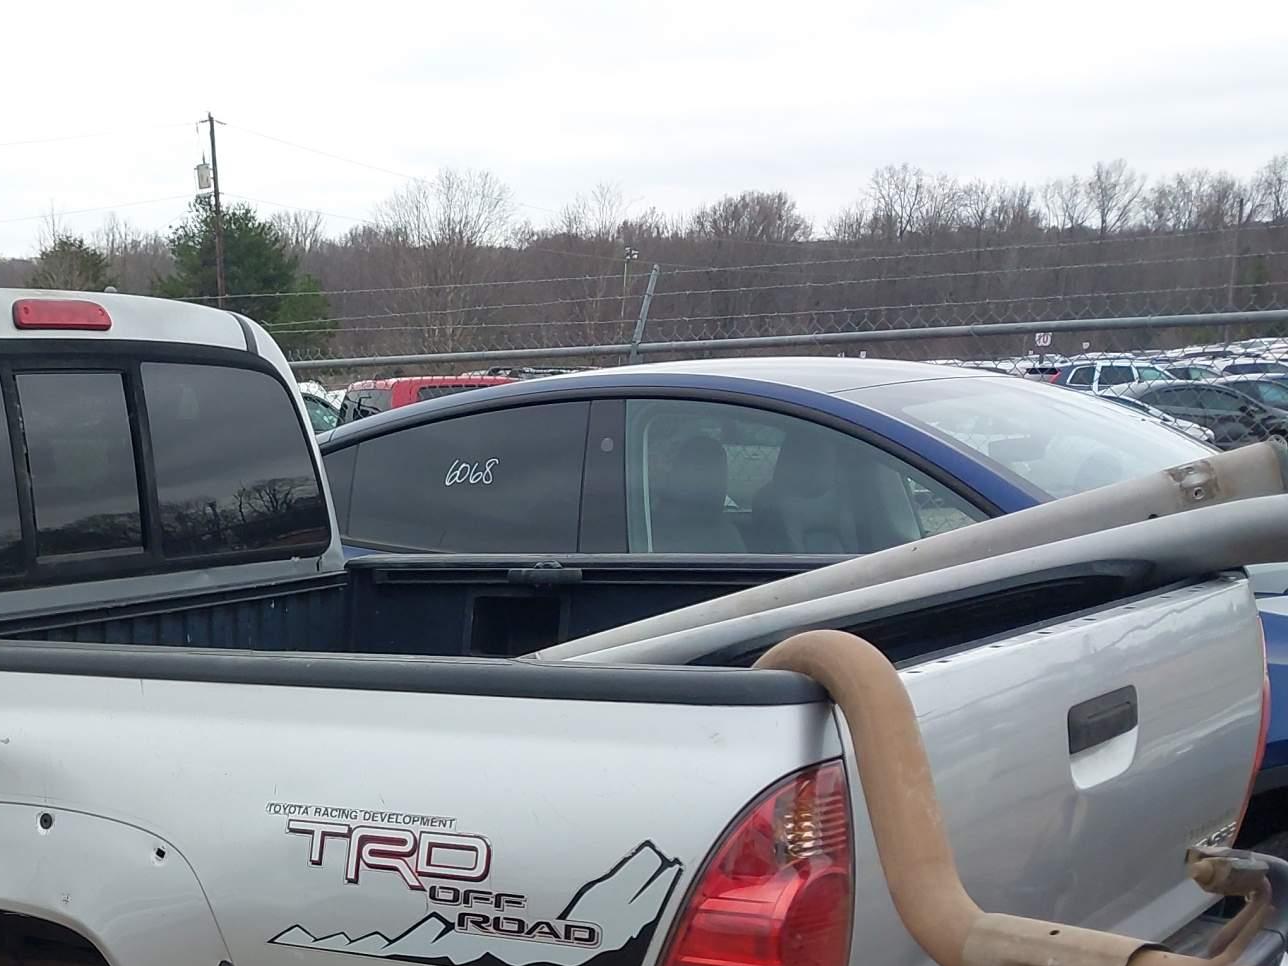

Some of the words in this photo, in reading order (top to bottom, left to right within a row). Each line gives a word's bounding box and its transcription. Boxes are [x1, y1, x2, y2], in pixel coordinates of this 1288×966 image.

[445, 458, 499, 486] 6068
[267, 803, 311, 816] TOYOTA
[313, 807, 359, 820] RACING
[362, 811, 457, 829] DEVELOPMENT
[286, 818, 493, 891] TRD
[428, 885, 527, 911] OFF
[456, 912, 600, 947] ROAD
